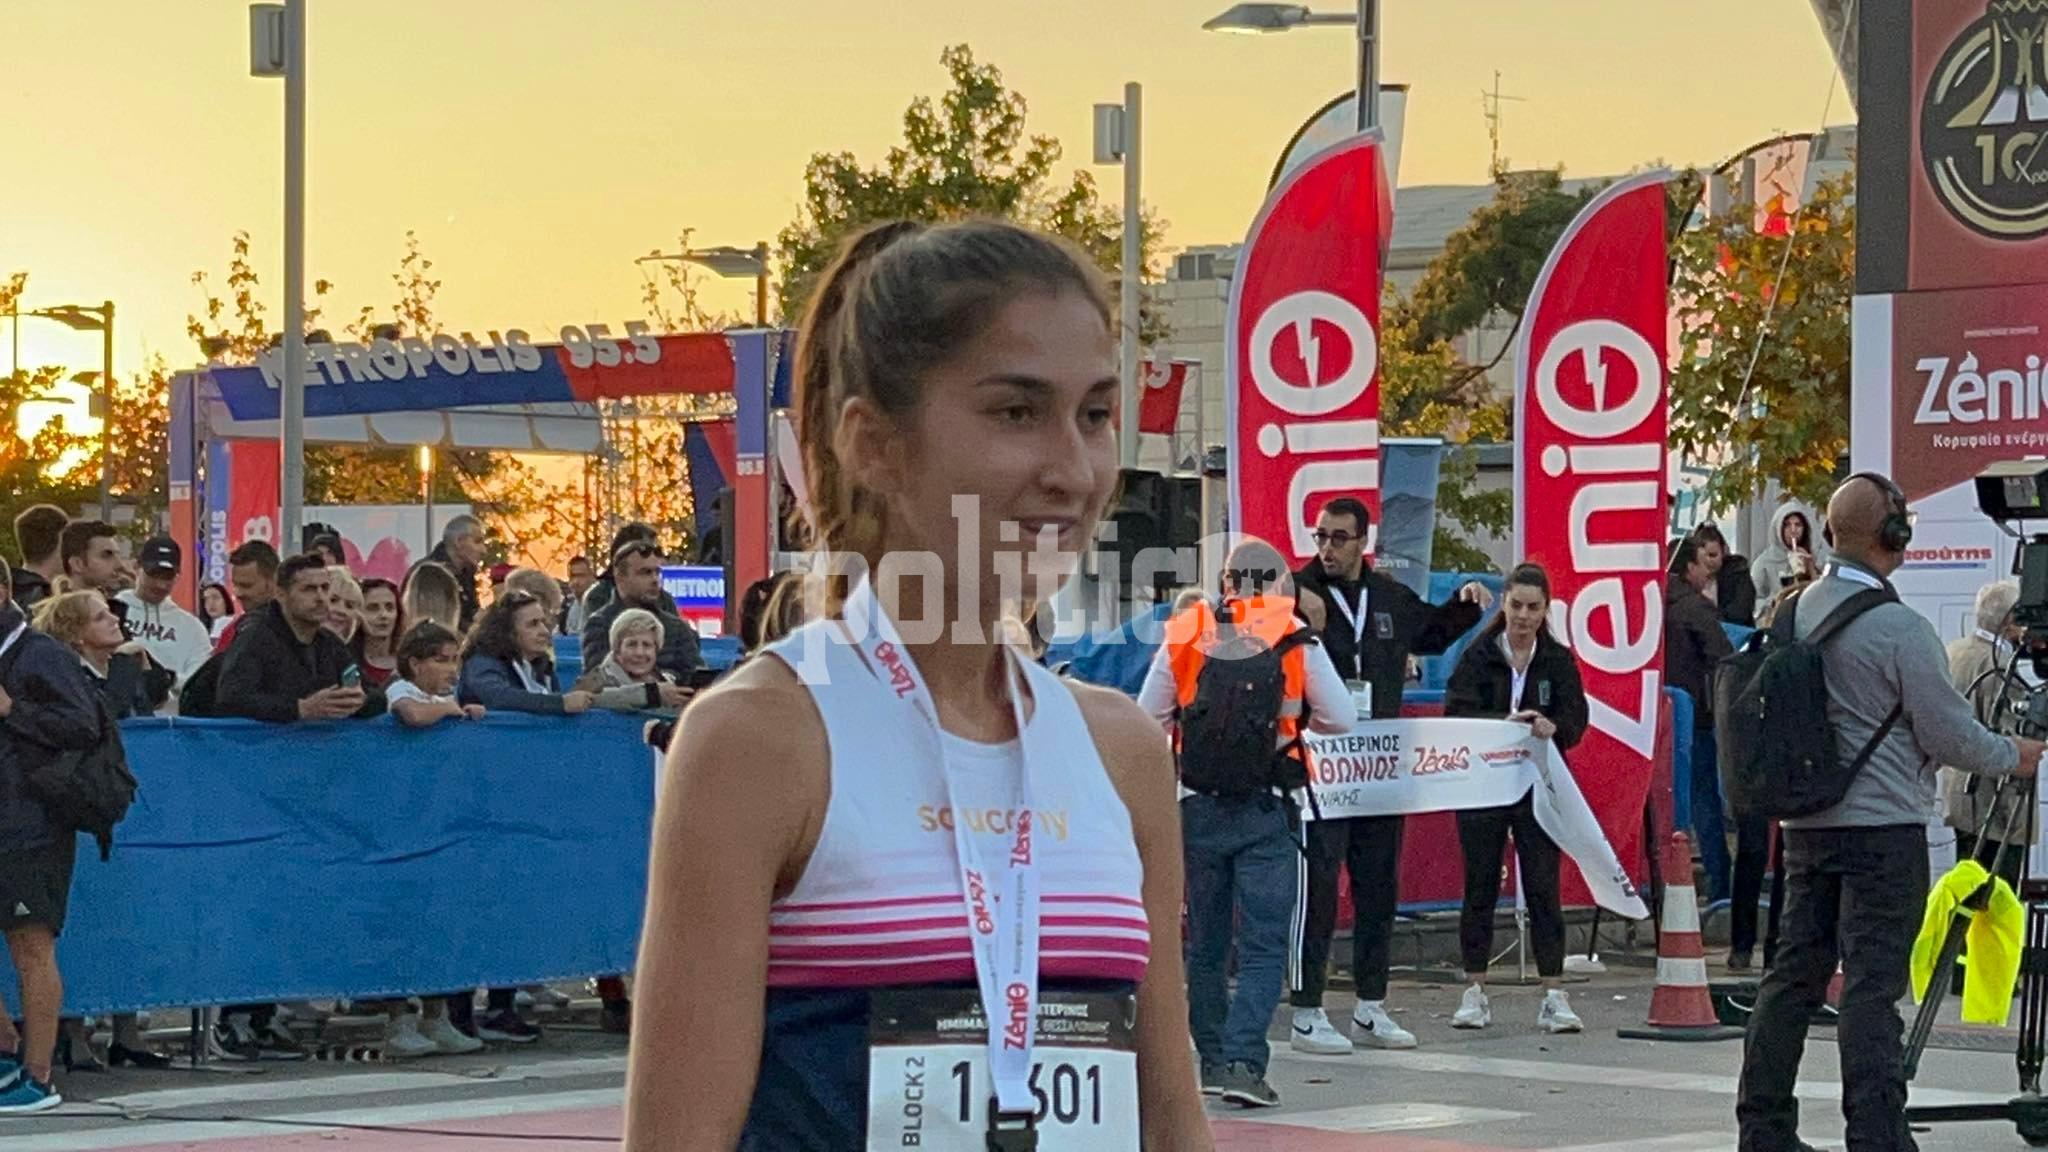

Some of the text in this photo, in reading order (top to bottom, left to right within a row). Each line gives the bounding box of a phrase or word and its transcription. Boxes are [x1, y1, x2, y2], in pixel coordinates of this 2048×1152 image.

[257, 320, 661, 389] METROPOLIS 95.5
[210, 510, 227, 585] OPOLIS
[662, 577, 725, 599] METRO
[902, 1056, 925, 1147] BLOCK 2
